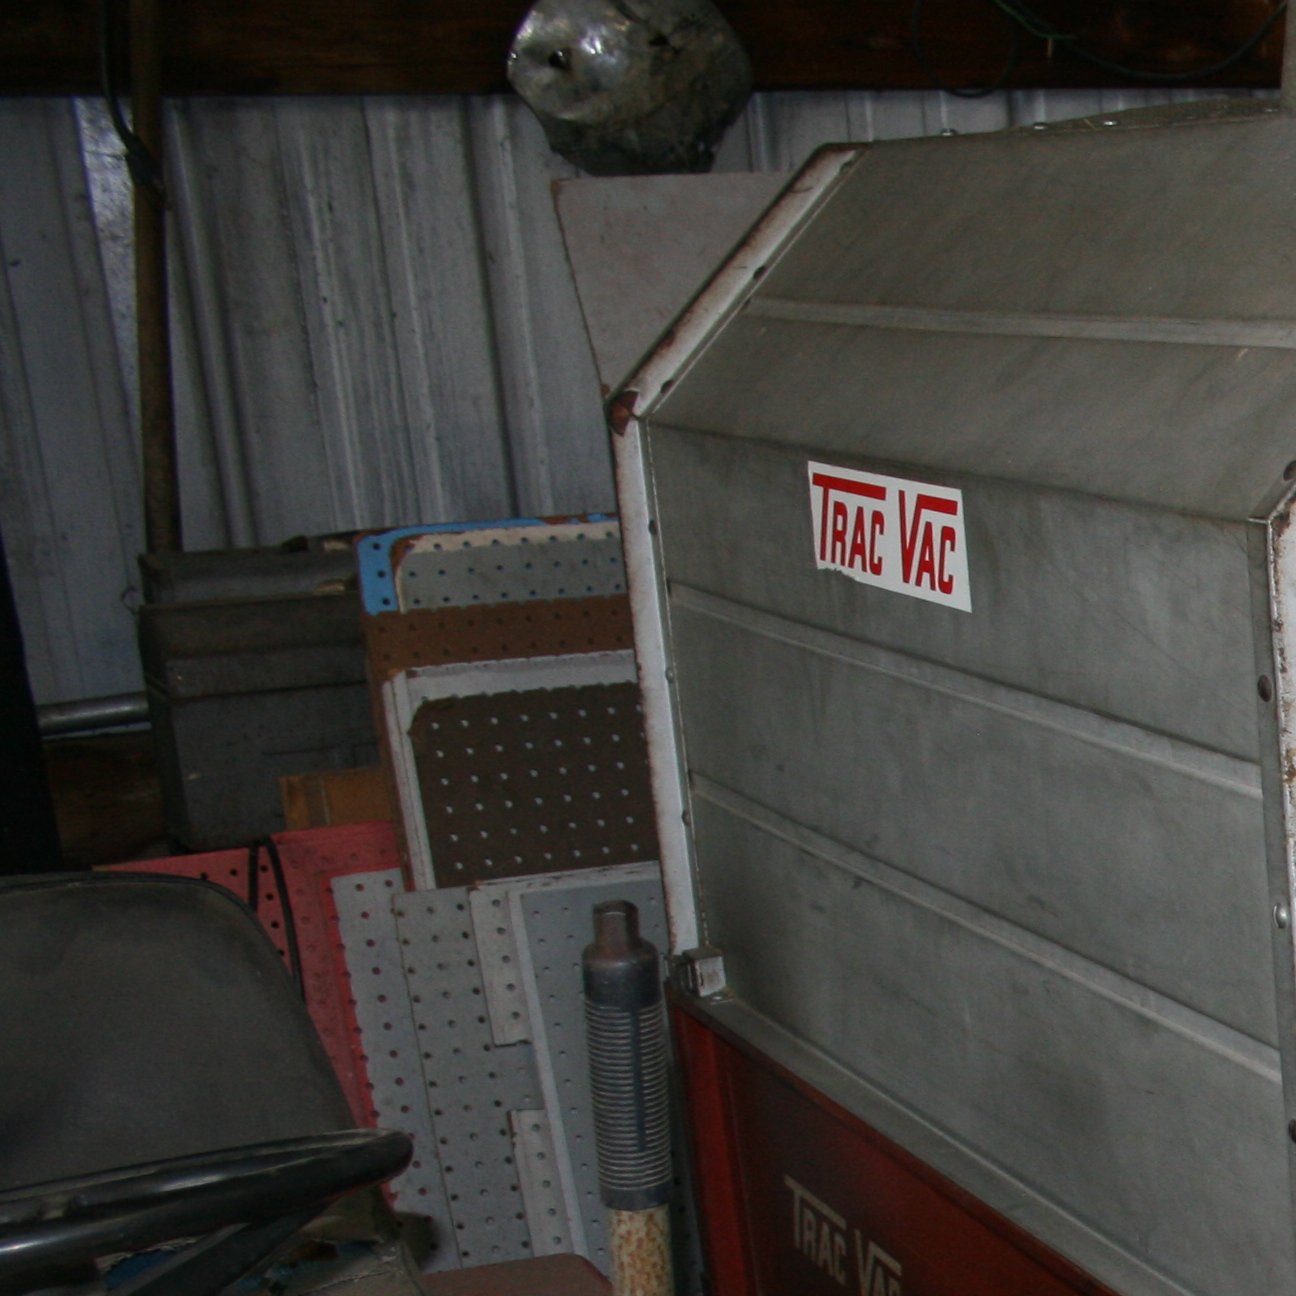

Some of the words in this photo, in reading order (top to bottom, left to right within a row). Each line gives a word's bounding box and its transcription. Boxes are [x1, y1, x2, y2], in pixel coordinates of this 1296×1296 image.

[812, 472, 886, 576] TRAC
[898, 489, 958, 595] VAC
[784, 1173, 847, 1286] TRAC
